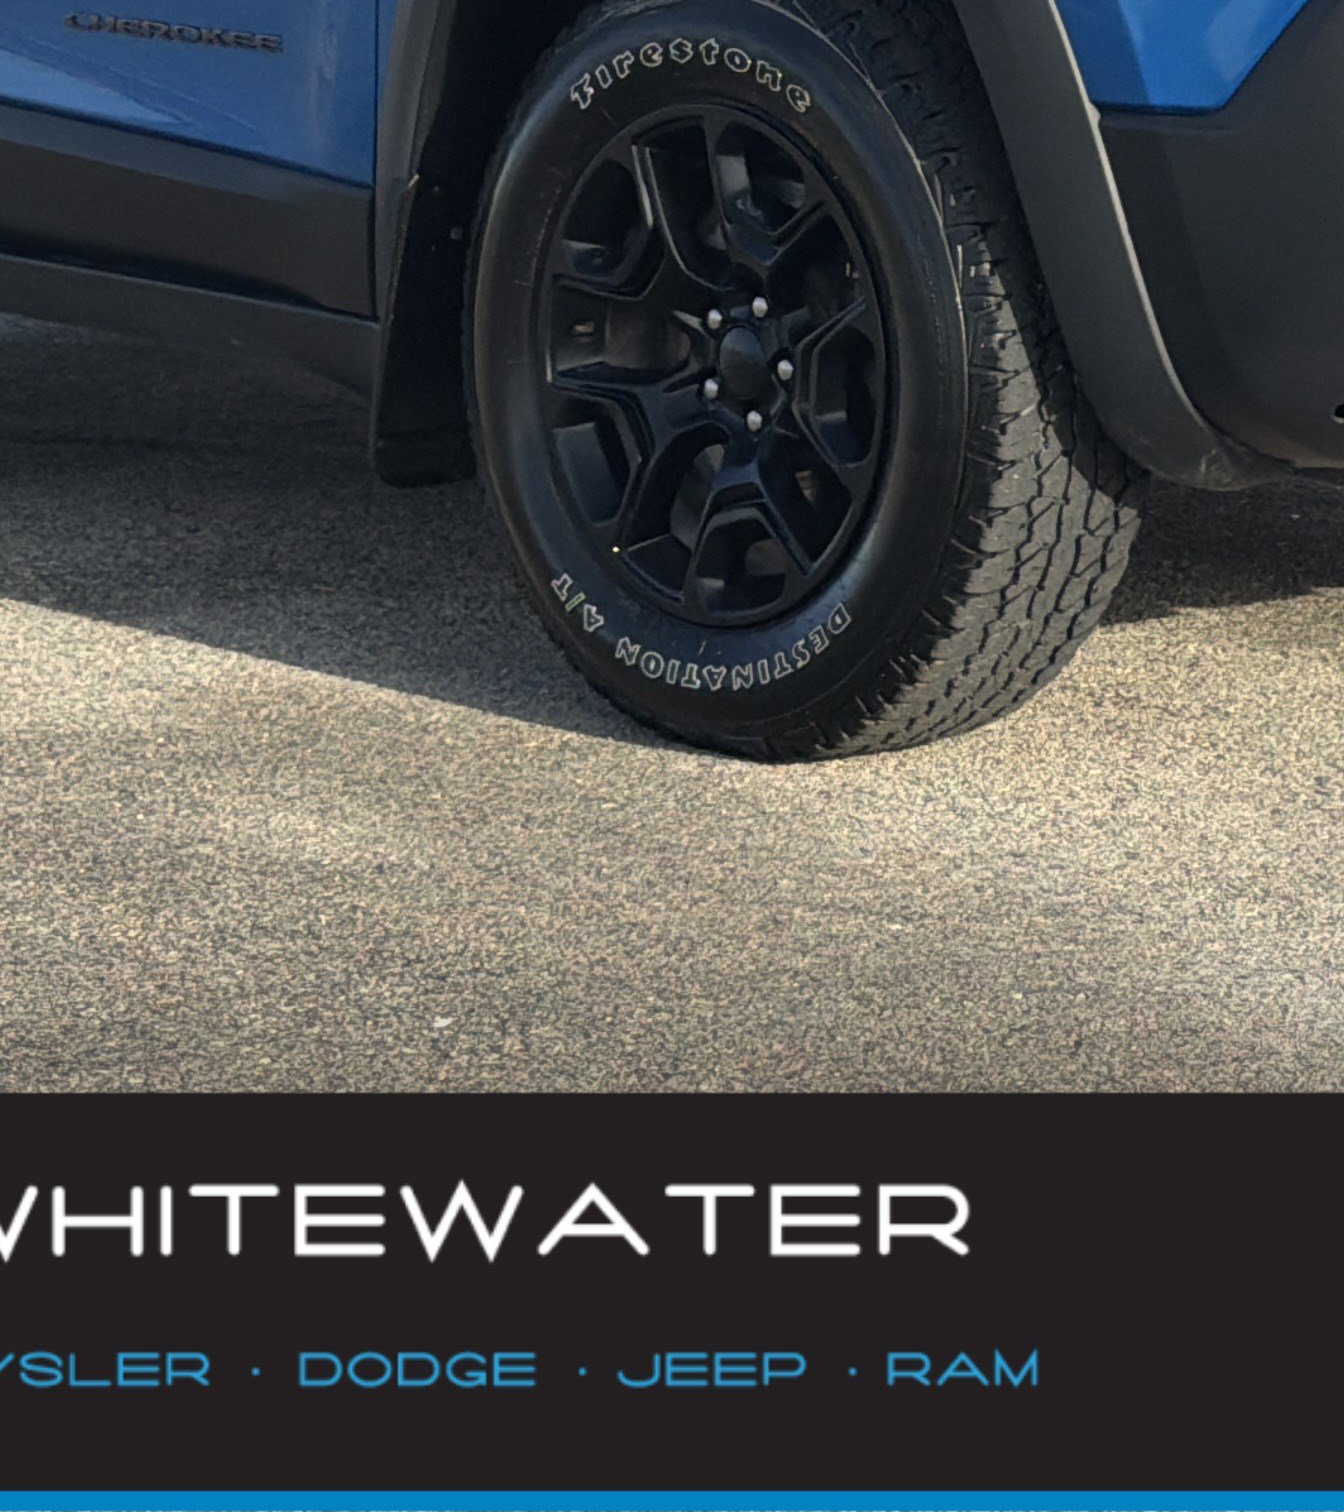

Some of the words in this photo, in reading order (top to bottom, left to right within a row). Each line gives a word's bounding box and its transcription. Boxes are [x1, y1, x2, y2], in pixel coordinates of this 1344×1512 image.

[65, 11, 283, 53] CHEROKEE
[570, 38, 811, 110] Firestone
[551, 573, 605, 633] A/T
[615, 602, 852, 691] DESTINATION
